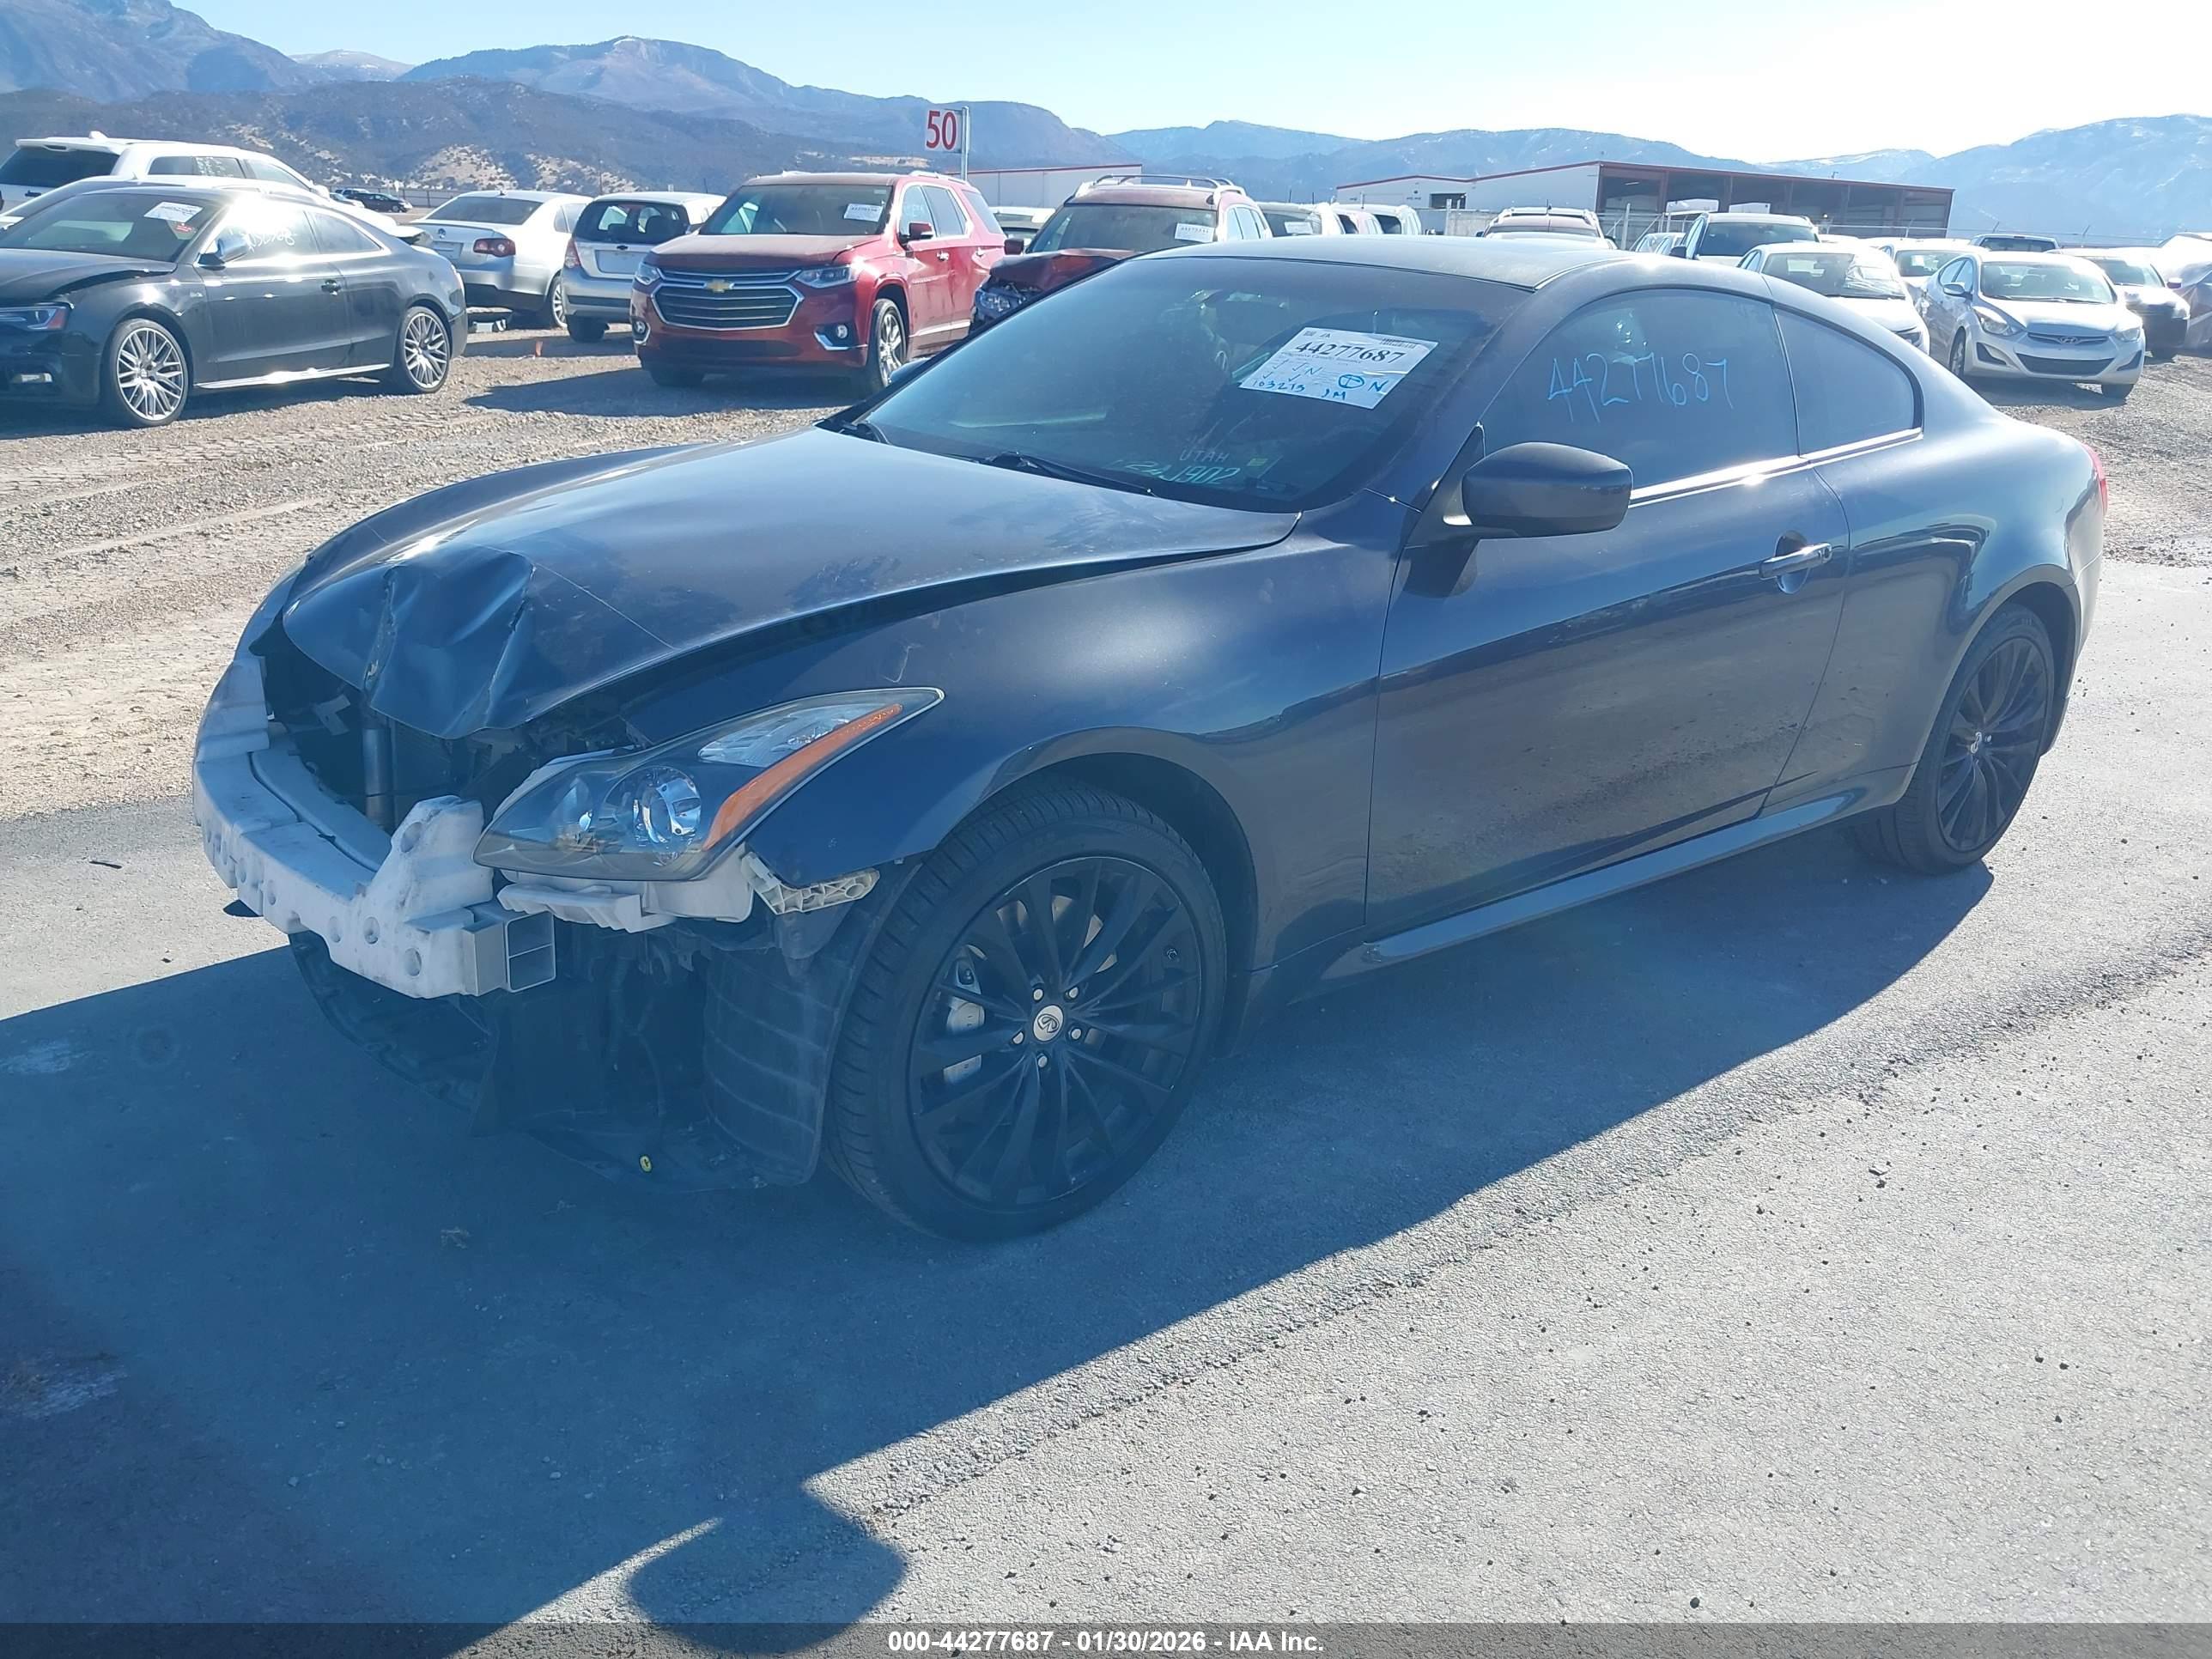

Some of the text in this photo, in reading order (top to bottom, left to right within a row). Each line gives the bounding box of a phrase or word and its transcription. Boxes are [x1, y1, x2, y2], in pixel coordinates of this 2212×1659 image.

[927, 110, 957, 150] 50
[1296, 342, 1407, 364] 44277687
[1547, 352, 1734, 423] 44277687
[1180, 449, 1230, 462] UTAH
